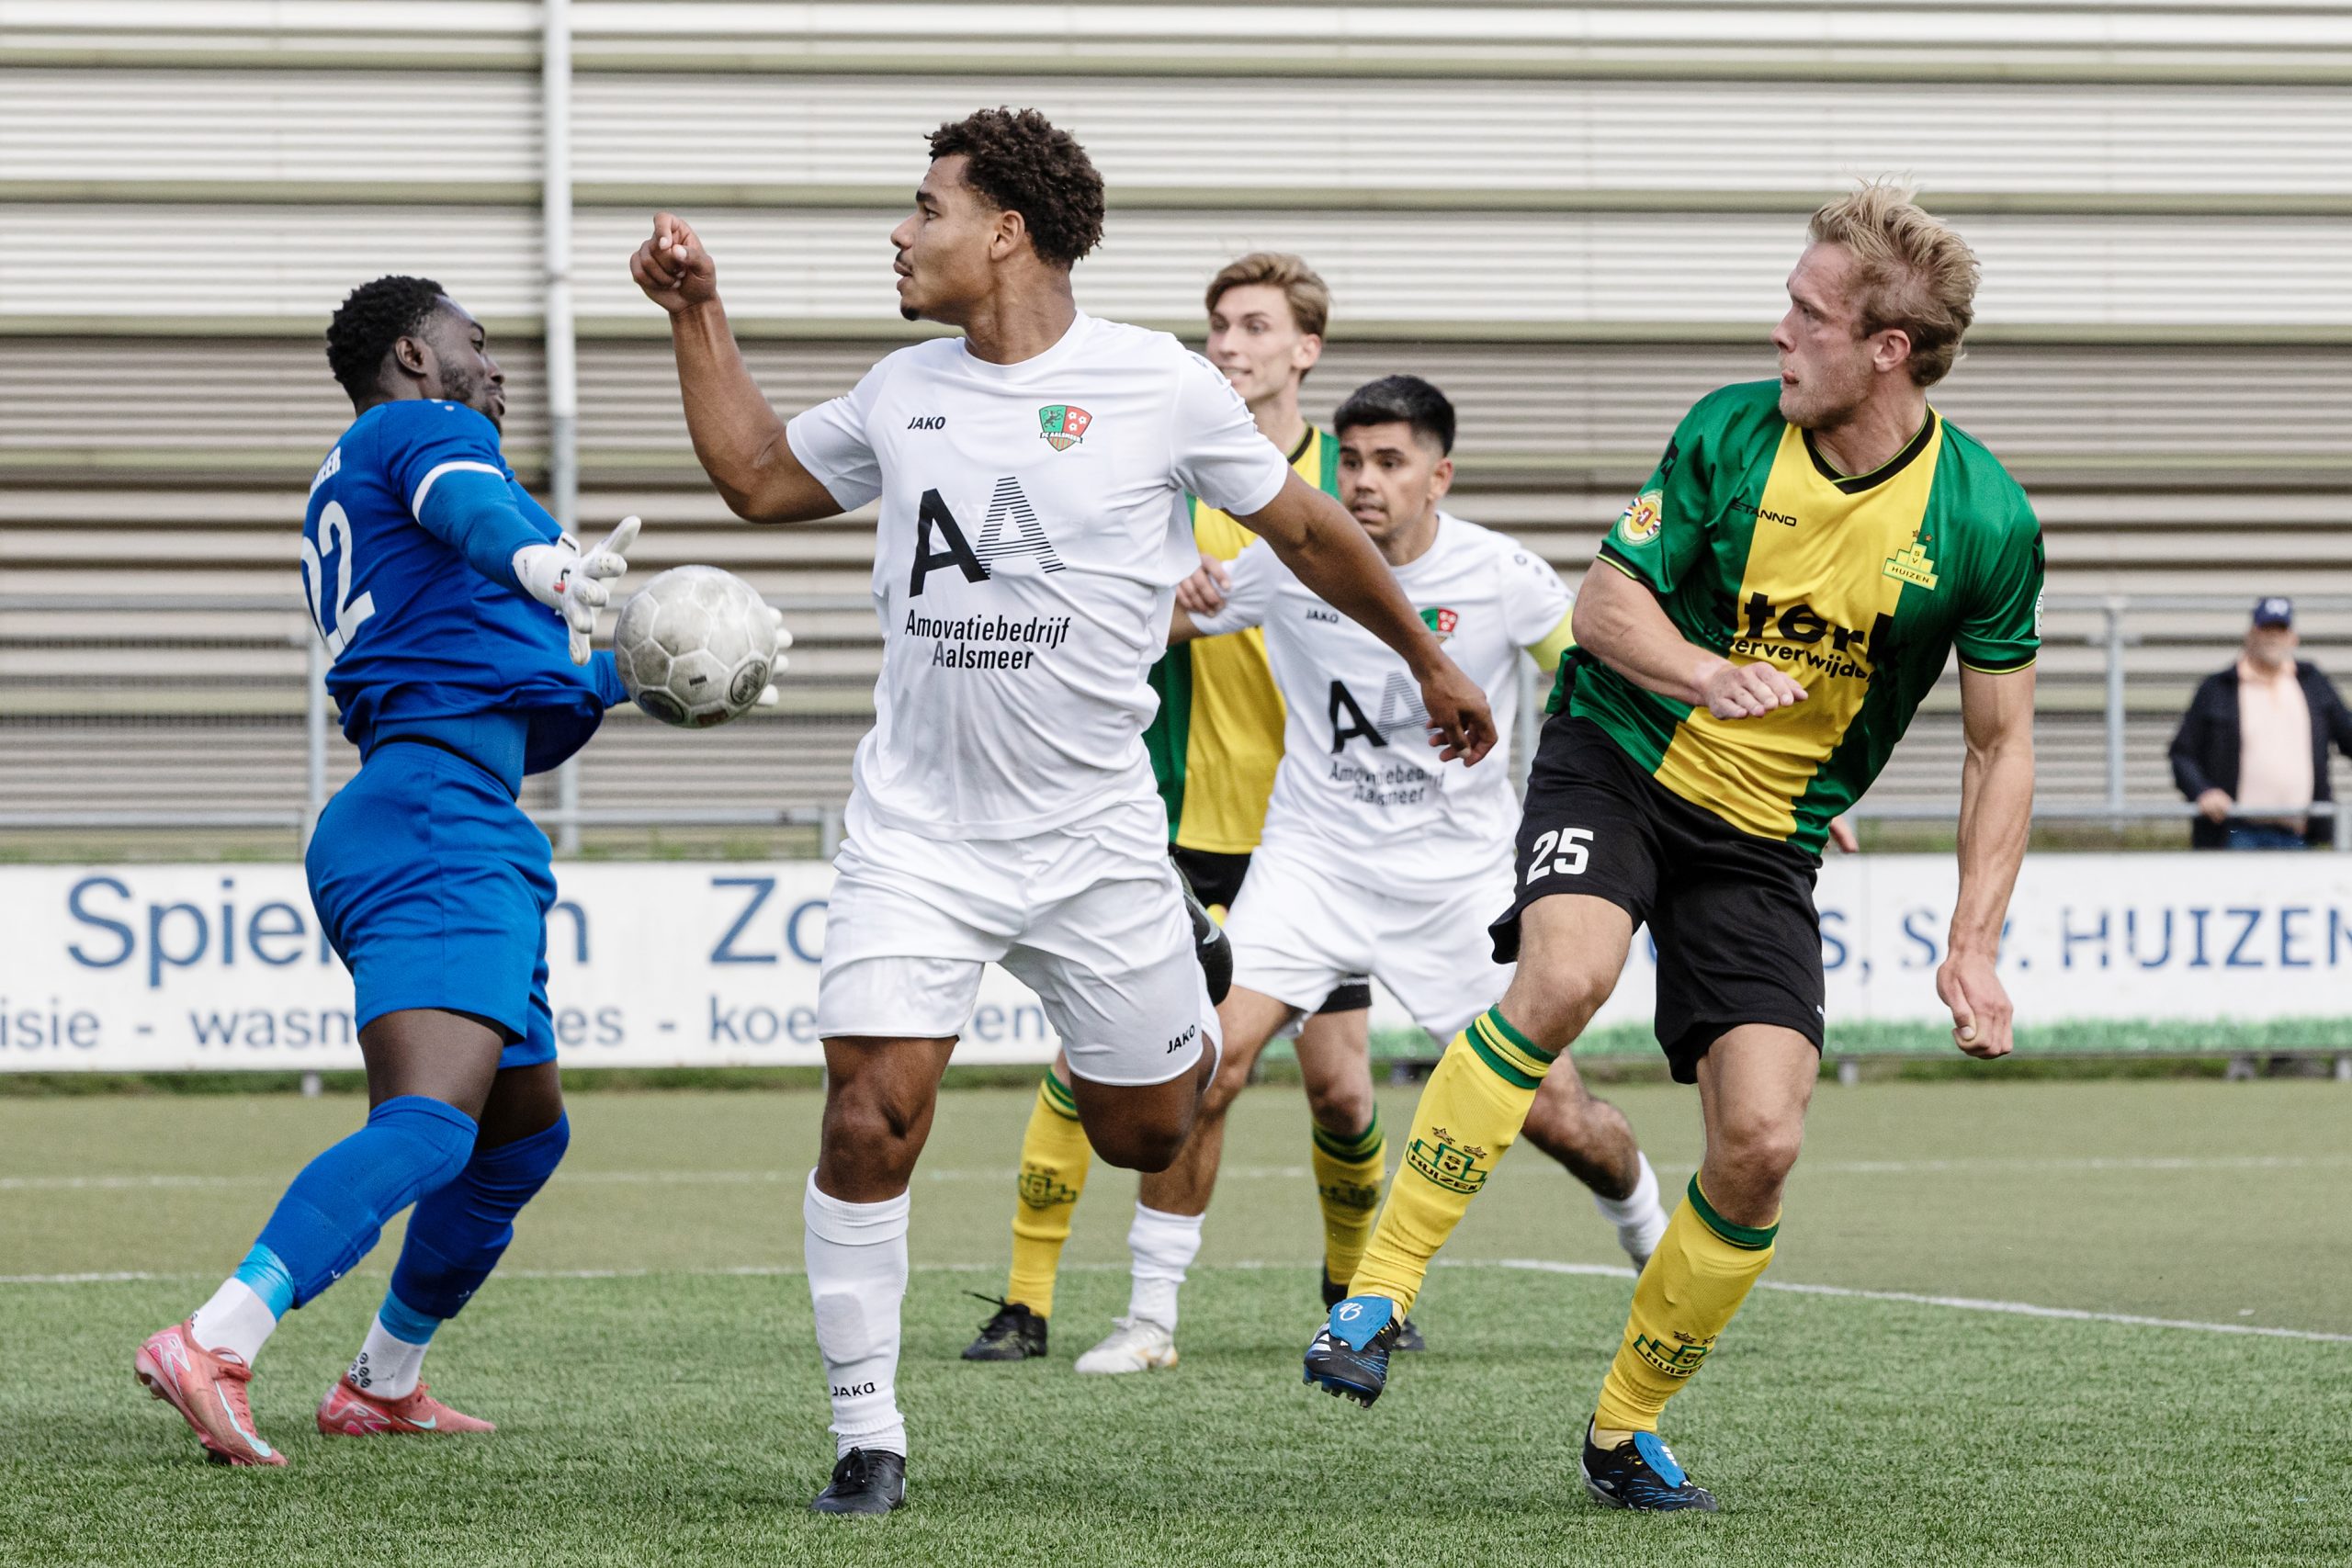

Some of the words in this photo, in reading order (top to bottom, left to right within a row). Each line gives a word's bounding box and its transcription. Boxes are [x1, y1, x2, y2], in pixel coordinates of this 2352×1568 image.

[907, 416, 946, 431] JAKO
[1891, 566, 1930, 583] HUIZEN
[904, 609, 1071, 649] Amovatiebedrijf
[932, 640, 1035, 670] Aalsmeer
[1526, 827, 1594, 886] 25
[1166, 1023, 1195, 1055] JAKO
[1410, 1154, 1478, 1191] HUIZEN
[831, 1382, 876, 1397] JAKO
